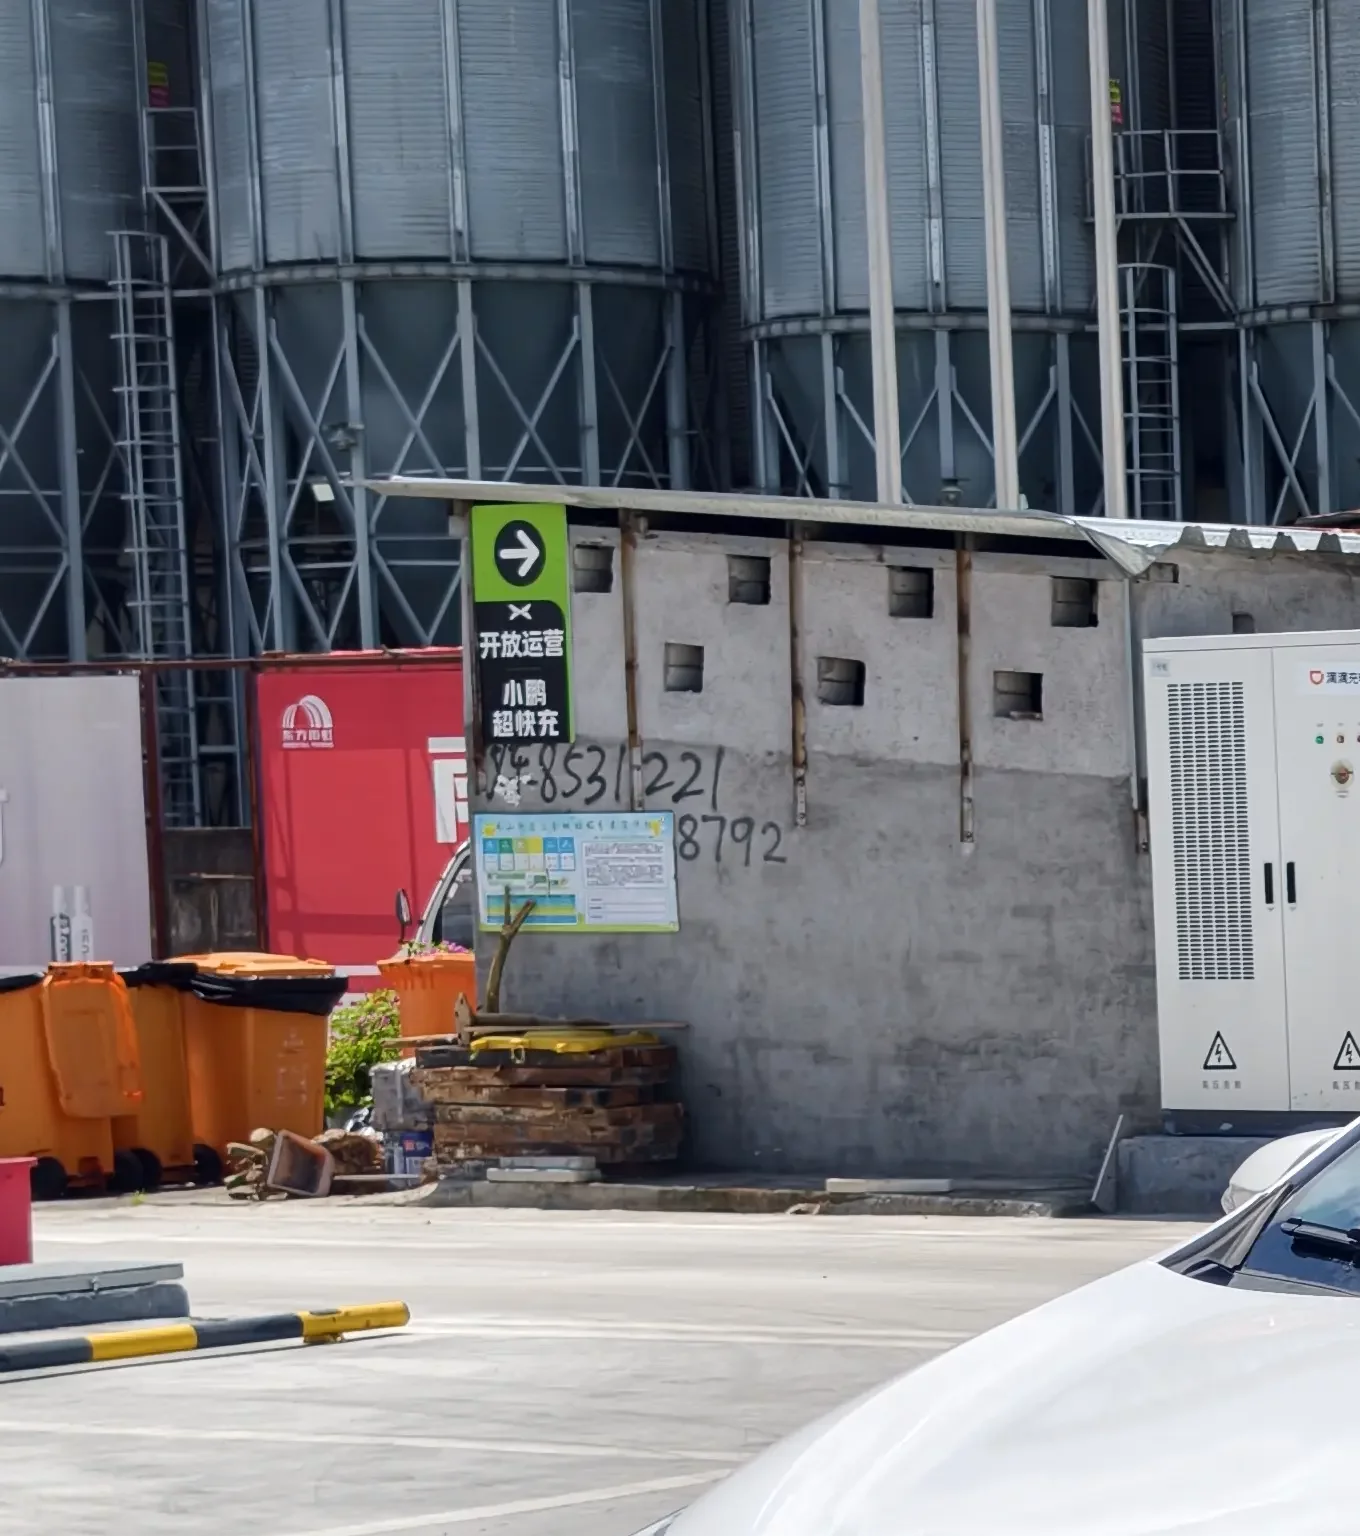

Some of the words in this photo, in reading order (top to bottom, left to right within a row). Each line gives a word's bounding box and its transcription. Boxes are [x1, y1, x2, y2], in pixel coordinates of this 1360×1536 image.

[480, 629, 564, 659] 开放运营
[503, 679, 546, 707] 小鹏
[492, 709, 560, 738] 超快充
